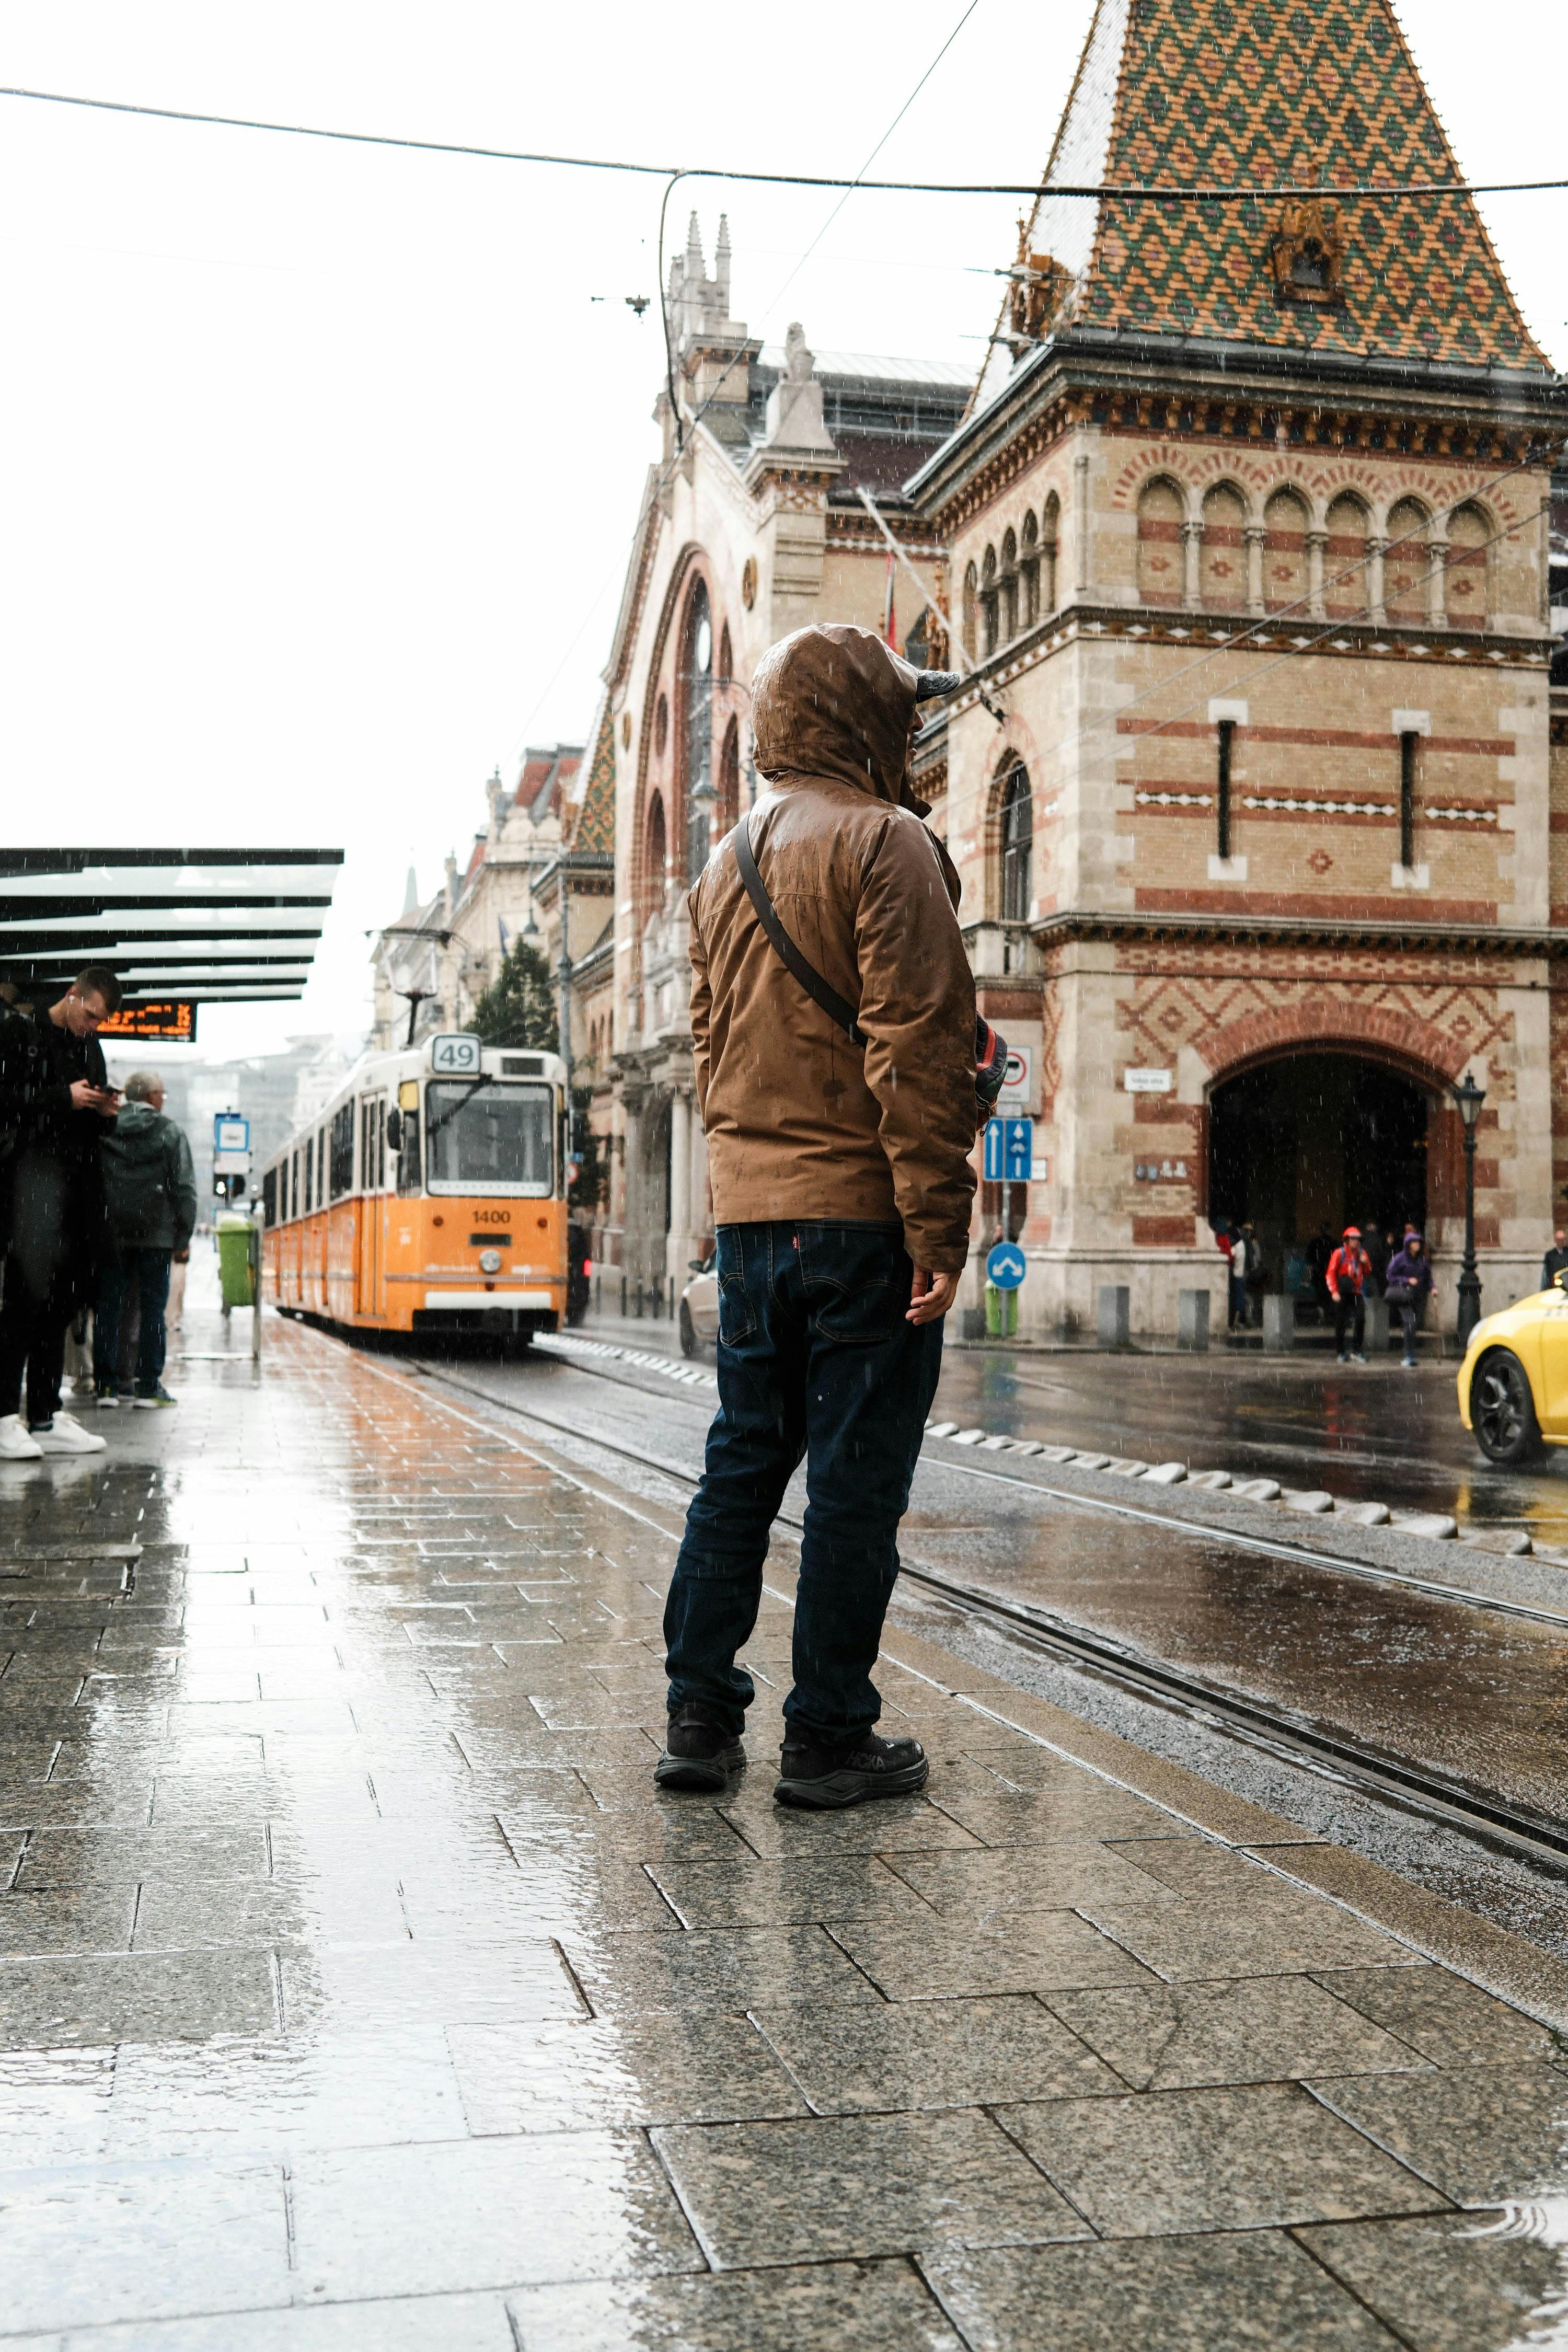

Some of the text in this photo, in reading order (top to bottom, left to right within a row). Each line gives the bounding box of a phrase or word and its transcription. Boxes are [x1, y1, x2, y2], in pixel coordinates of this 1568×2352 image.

[439, 1044, 474, 1066] 49
[472, 1210, 511, 1224] 1400
[845, 1751, 886, 1771] HOKA
